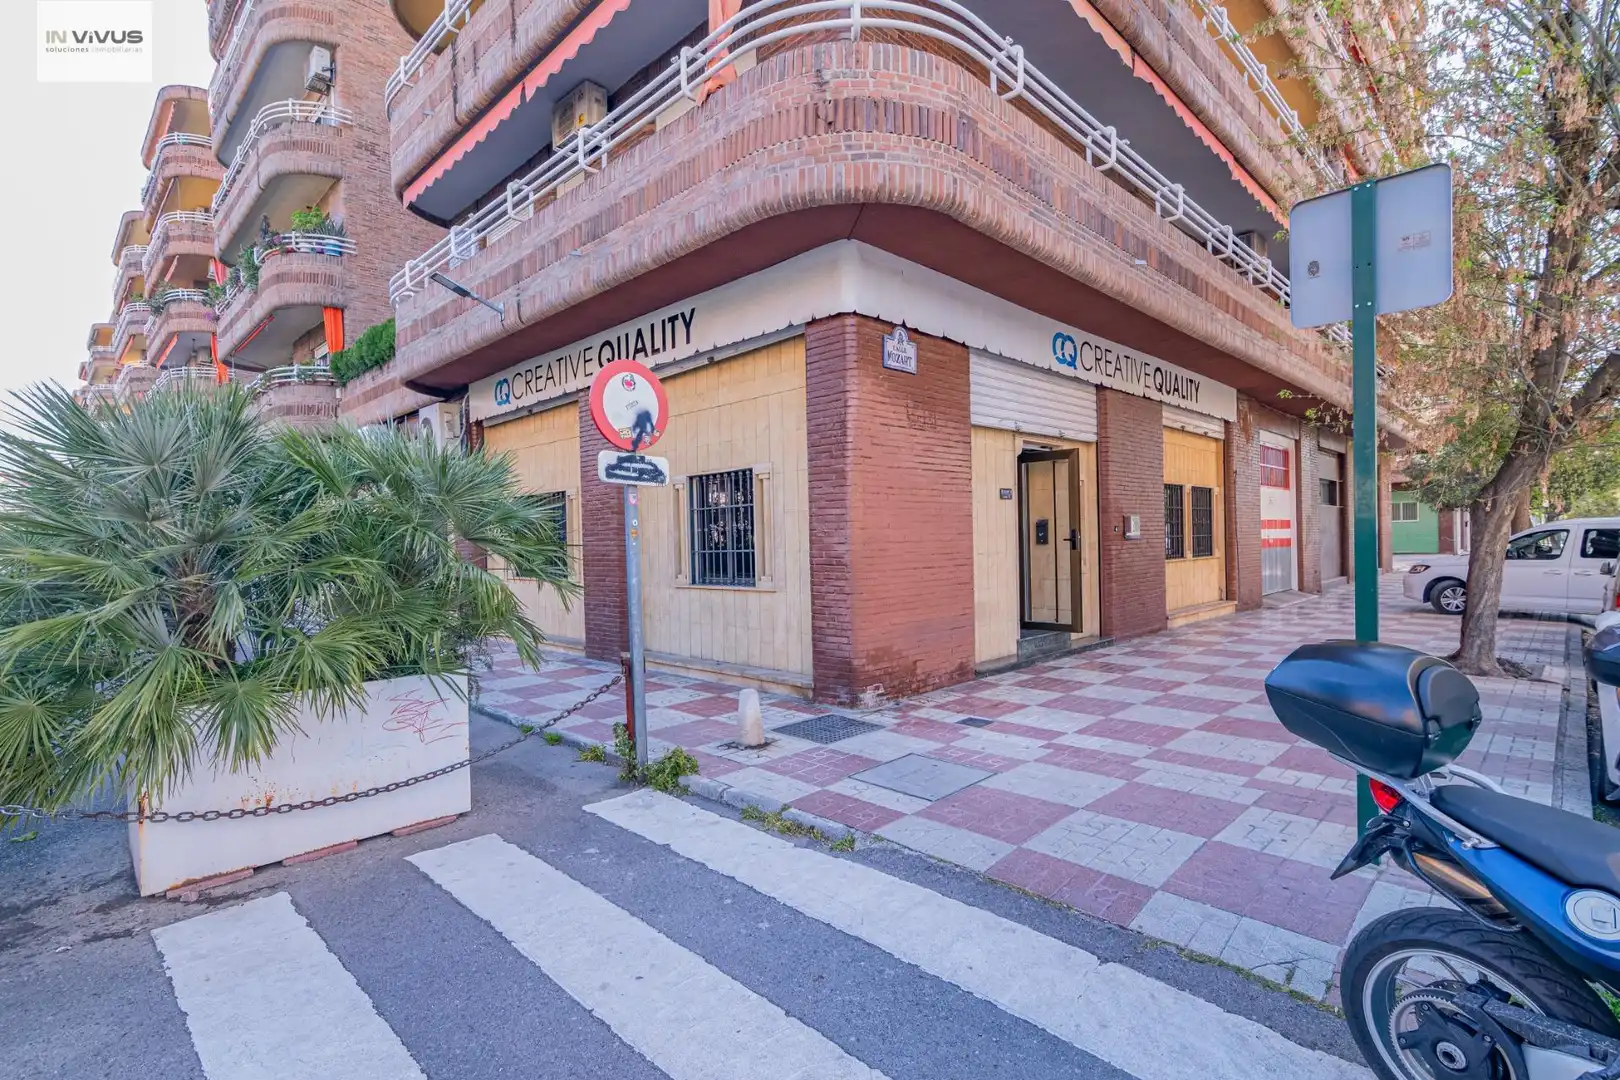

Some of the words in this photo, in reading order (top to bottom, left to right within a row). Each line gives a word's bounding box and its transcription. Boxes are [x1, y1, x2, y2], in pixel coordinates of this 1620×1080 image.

[511, 346, 594, 400] CREATIVE
[597, 307, 696, 369] QUALITY
[887, 350, 913, 367] MOZART
[1079, 341, 1151, 389] CREATIVE
[1153, 366, 1201, 403] QUALITY
